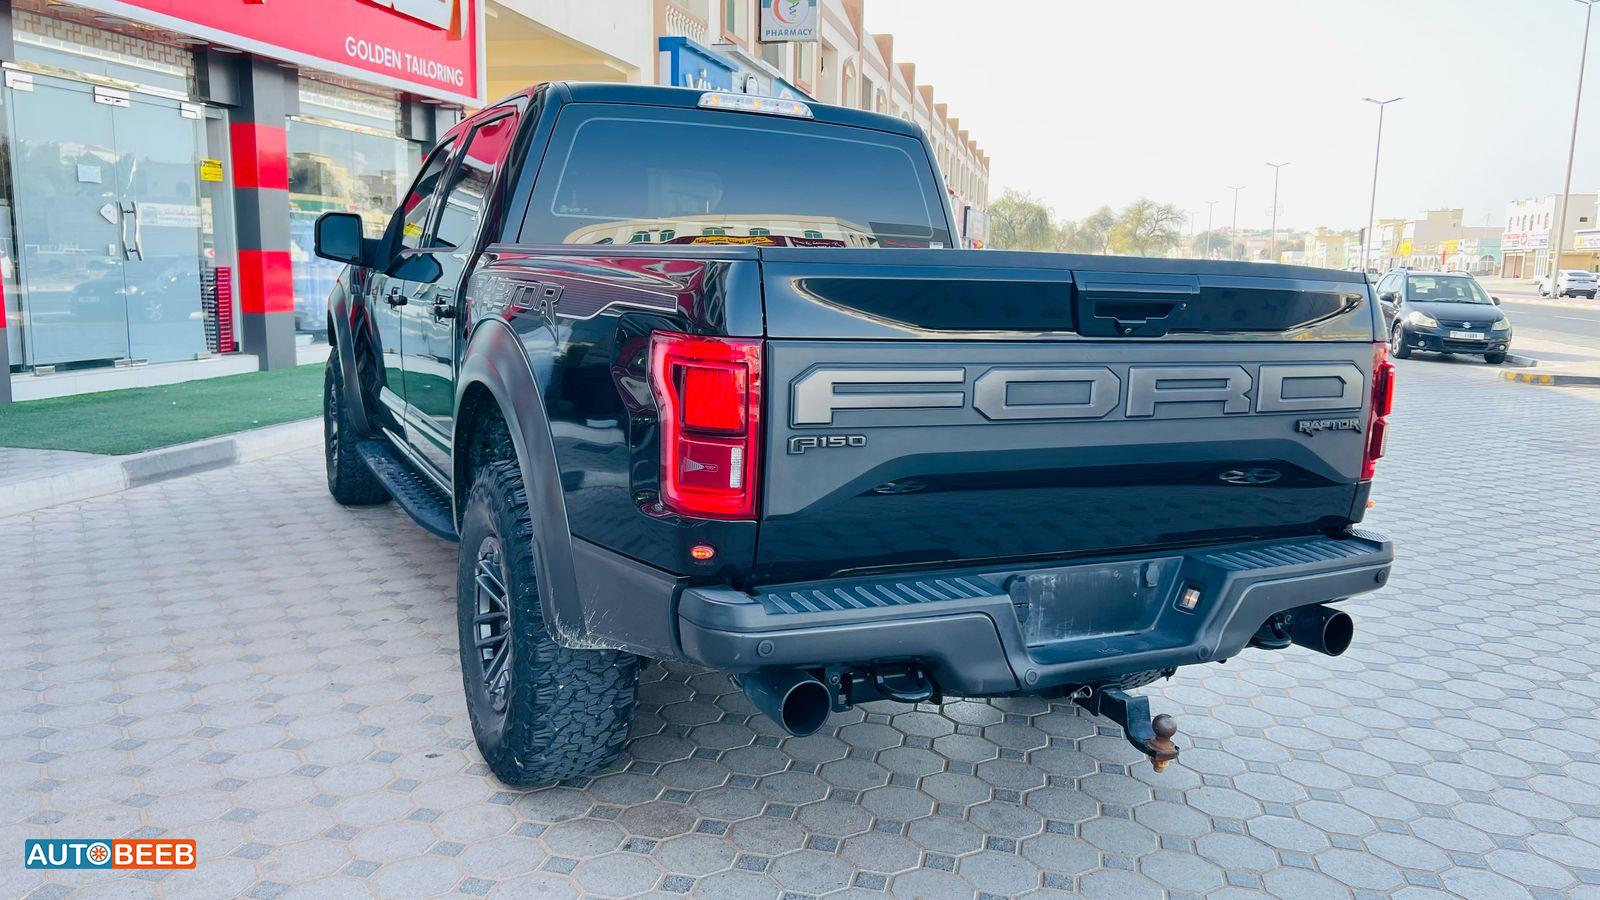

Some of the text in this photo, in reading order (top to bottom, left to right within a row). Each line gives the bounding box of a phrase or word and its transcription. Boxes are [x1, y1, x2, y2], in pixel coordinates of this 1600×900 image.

[765, 28, 814, 37] PHARMACY
[345, 35, 465, 87] GOLDEN TAILORING
[792, 363, 1365, 424] FORD
[1297, 418, 1363, 436] RAPTOR
[787, 434, 867, 454] F150
